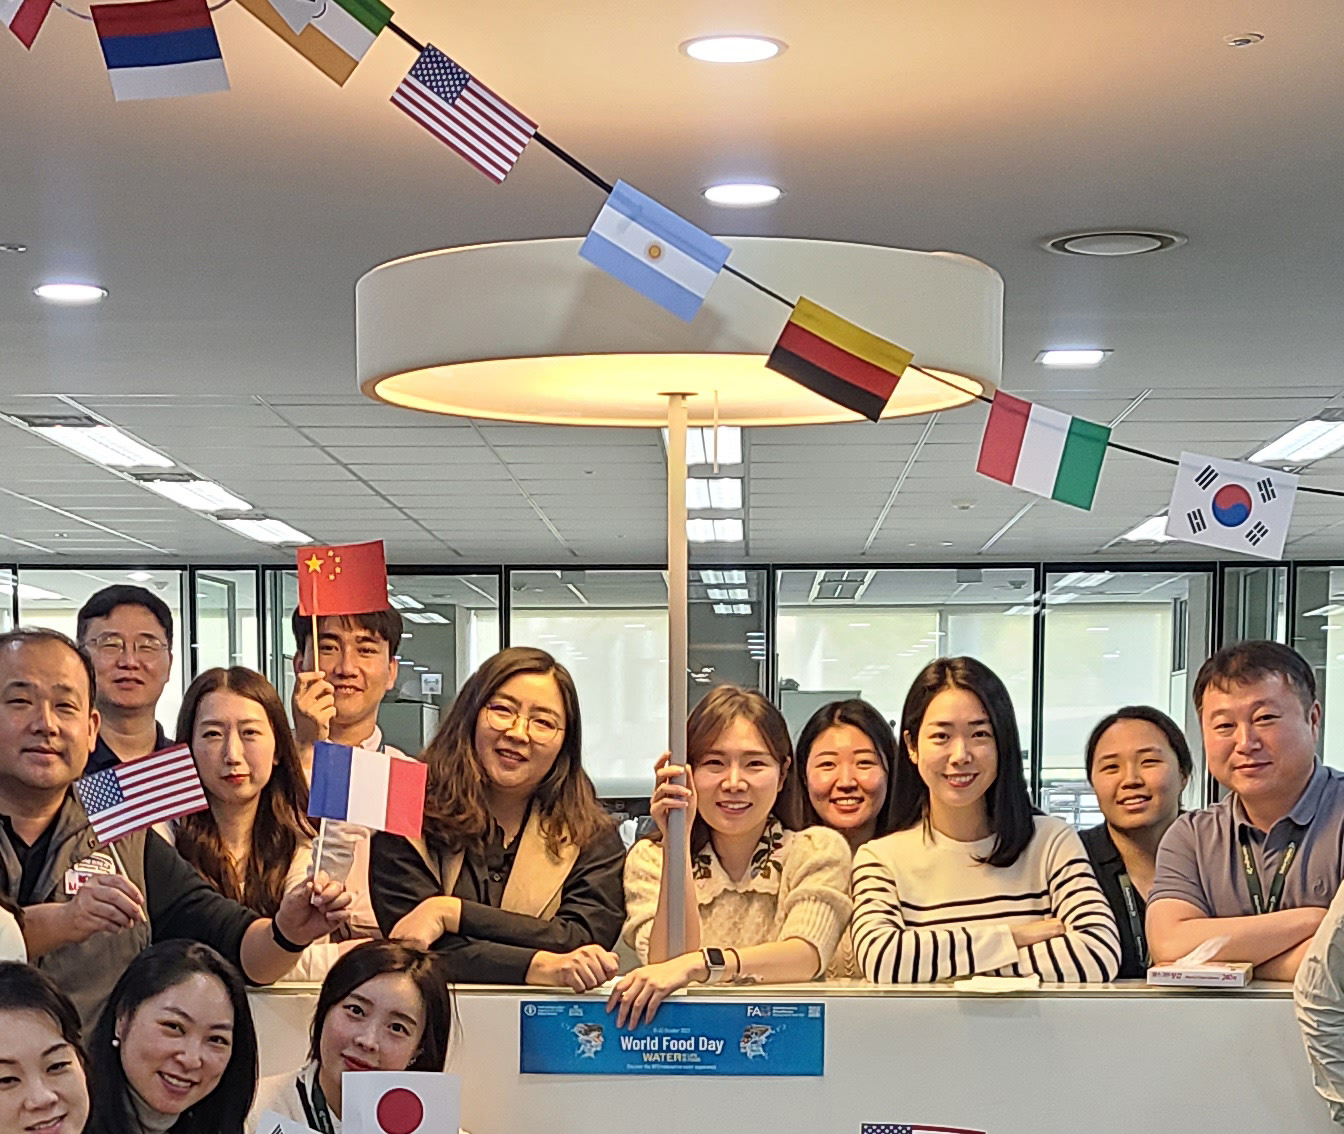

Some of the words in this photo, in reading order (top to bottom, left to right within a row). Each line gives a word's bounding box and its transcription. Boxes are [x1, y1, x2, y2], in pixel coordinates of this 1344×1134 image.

[620, 1036, 659, 1051] World
[662, 1036, 695, 1051] Food
[699, 1036, 725, 1055] Day
[642, 1052, 682, 1063] WATER
